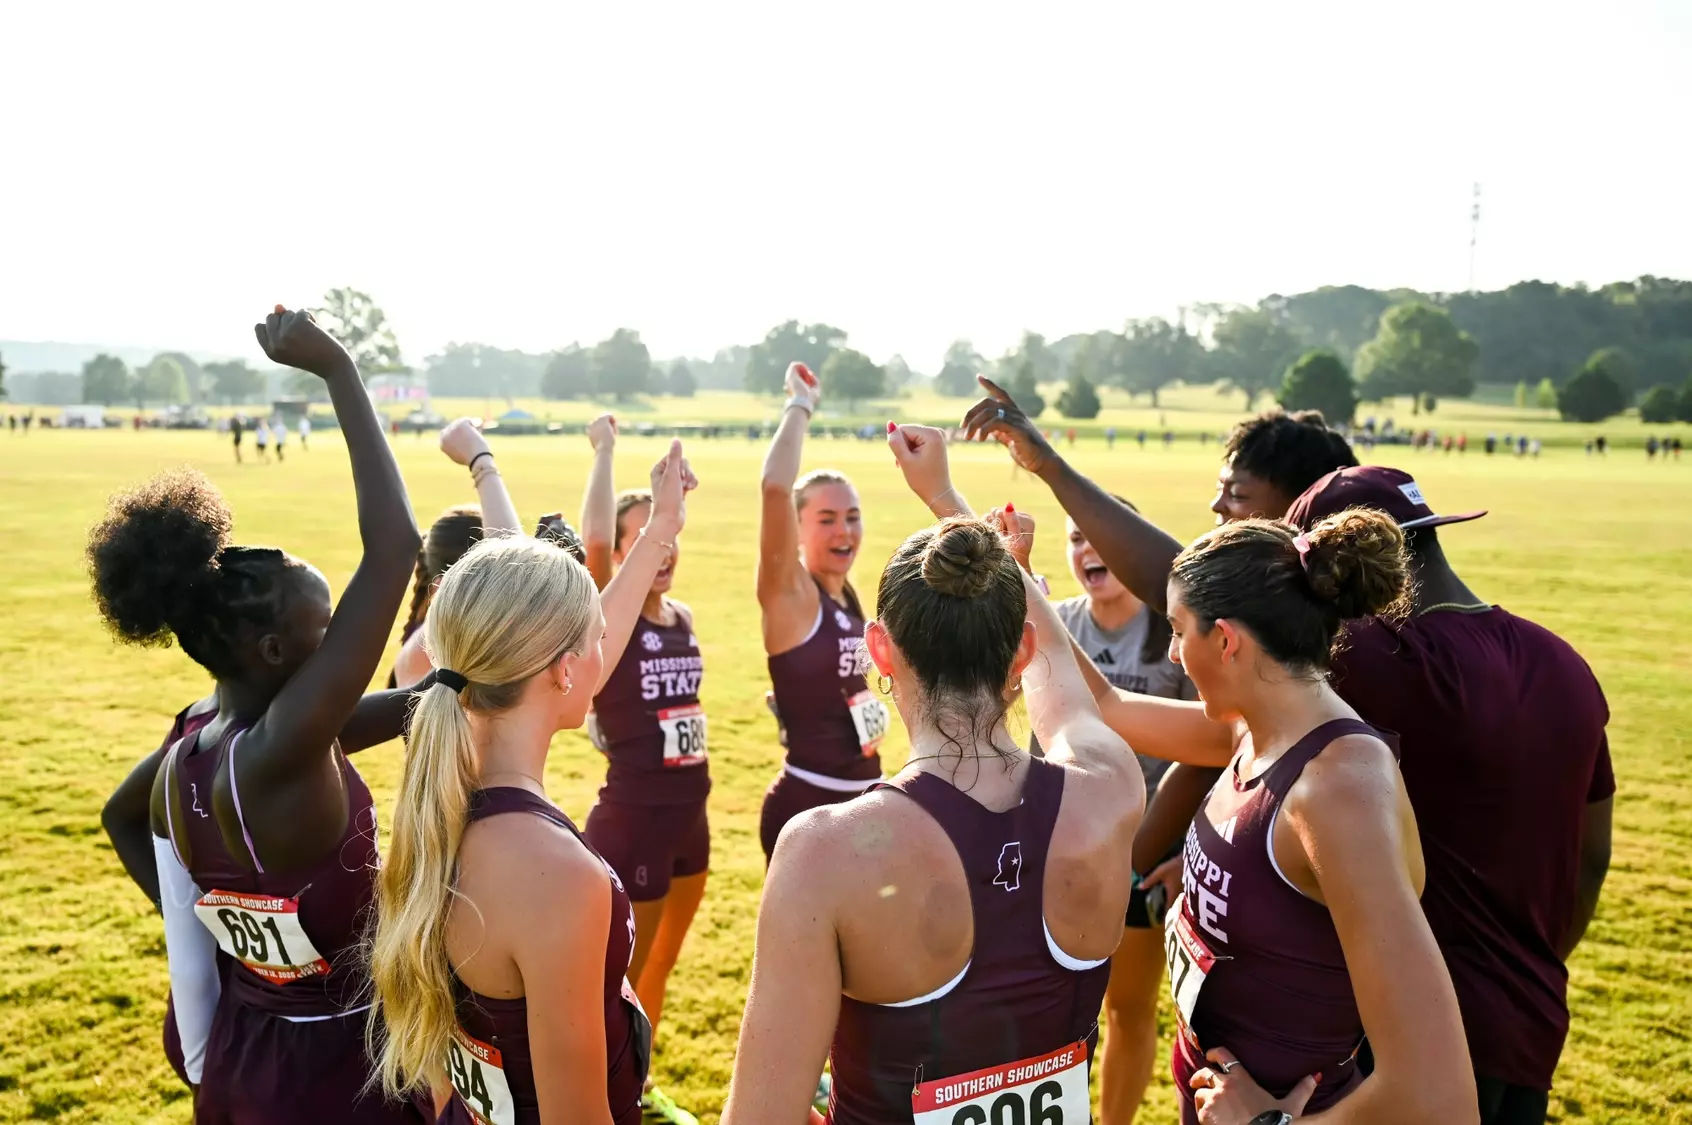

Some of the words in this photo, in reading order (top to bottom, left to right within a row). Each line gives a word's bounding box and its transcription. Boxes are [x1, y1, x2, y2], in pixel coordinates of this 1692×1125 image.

[203, 893, 240, 906] SOUTHERN
[240, 897, 285, 911] SHOWCASE
[217, 908, 296, 969] 691
[1165, 920, 1190, 1003] 97
[935, 1072, 1004, 1104] SOUTHERN
[1007, 1050, 1074, 1083] SHOWCASE
